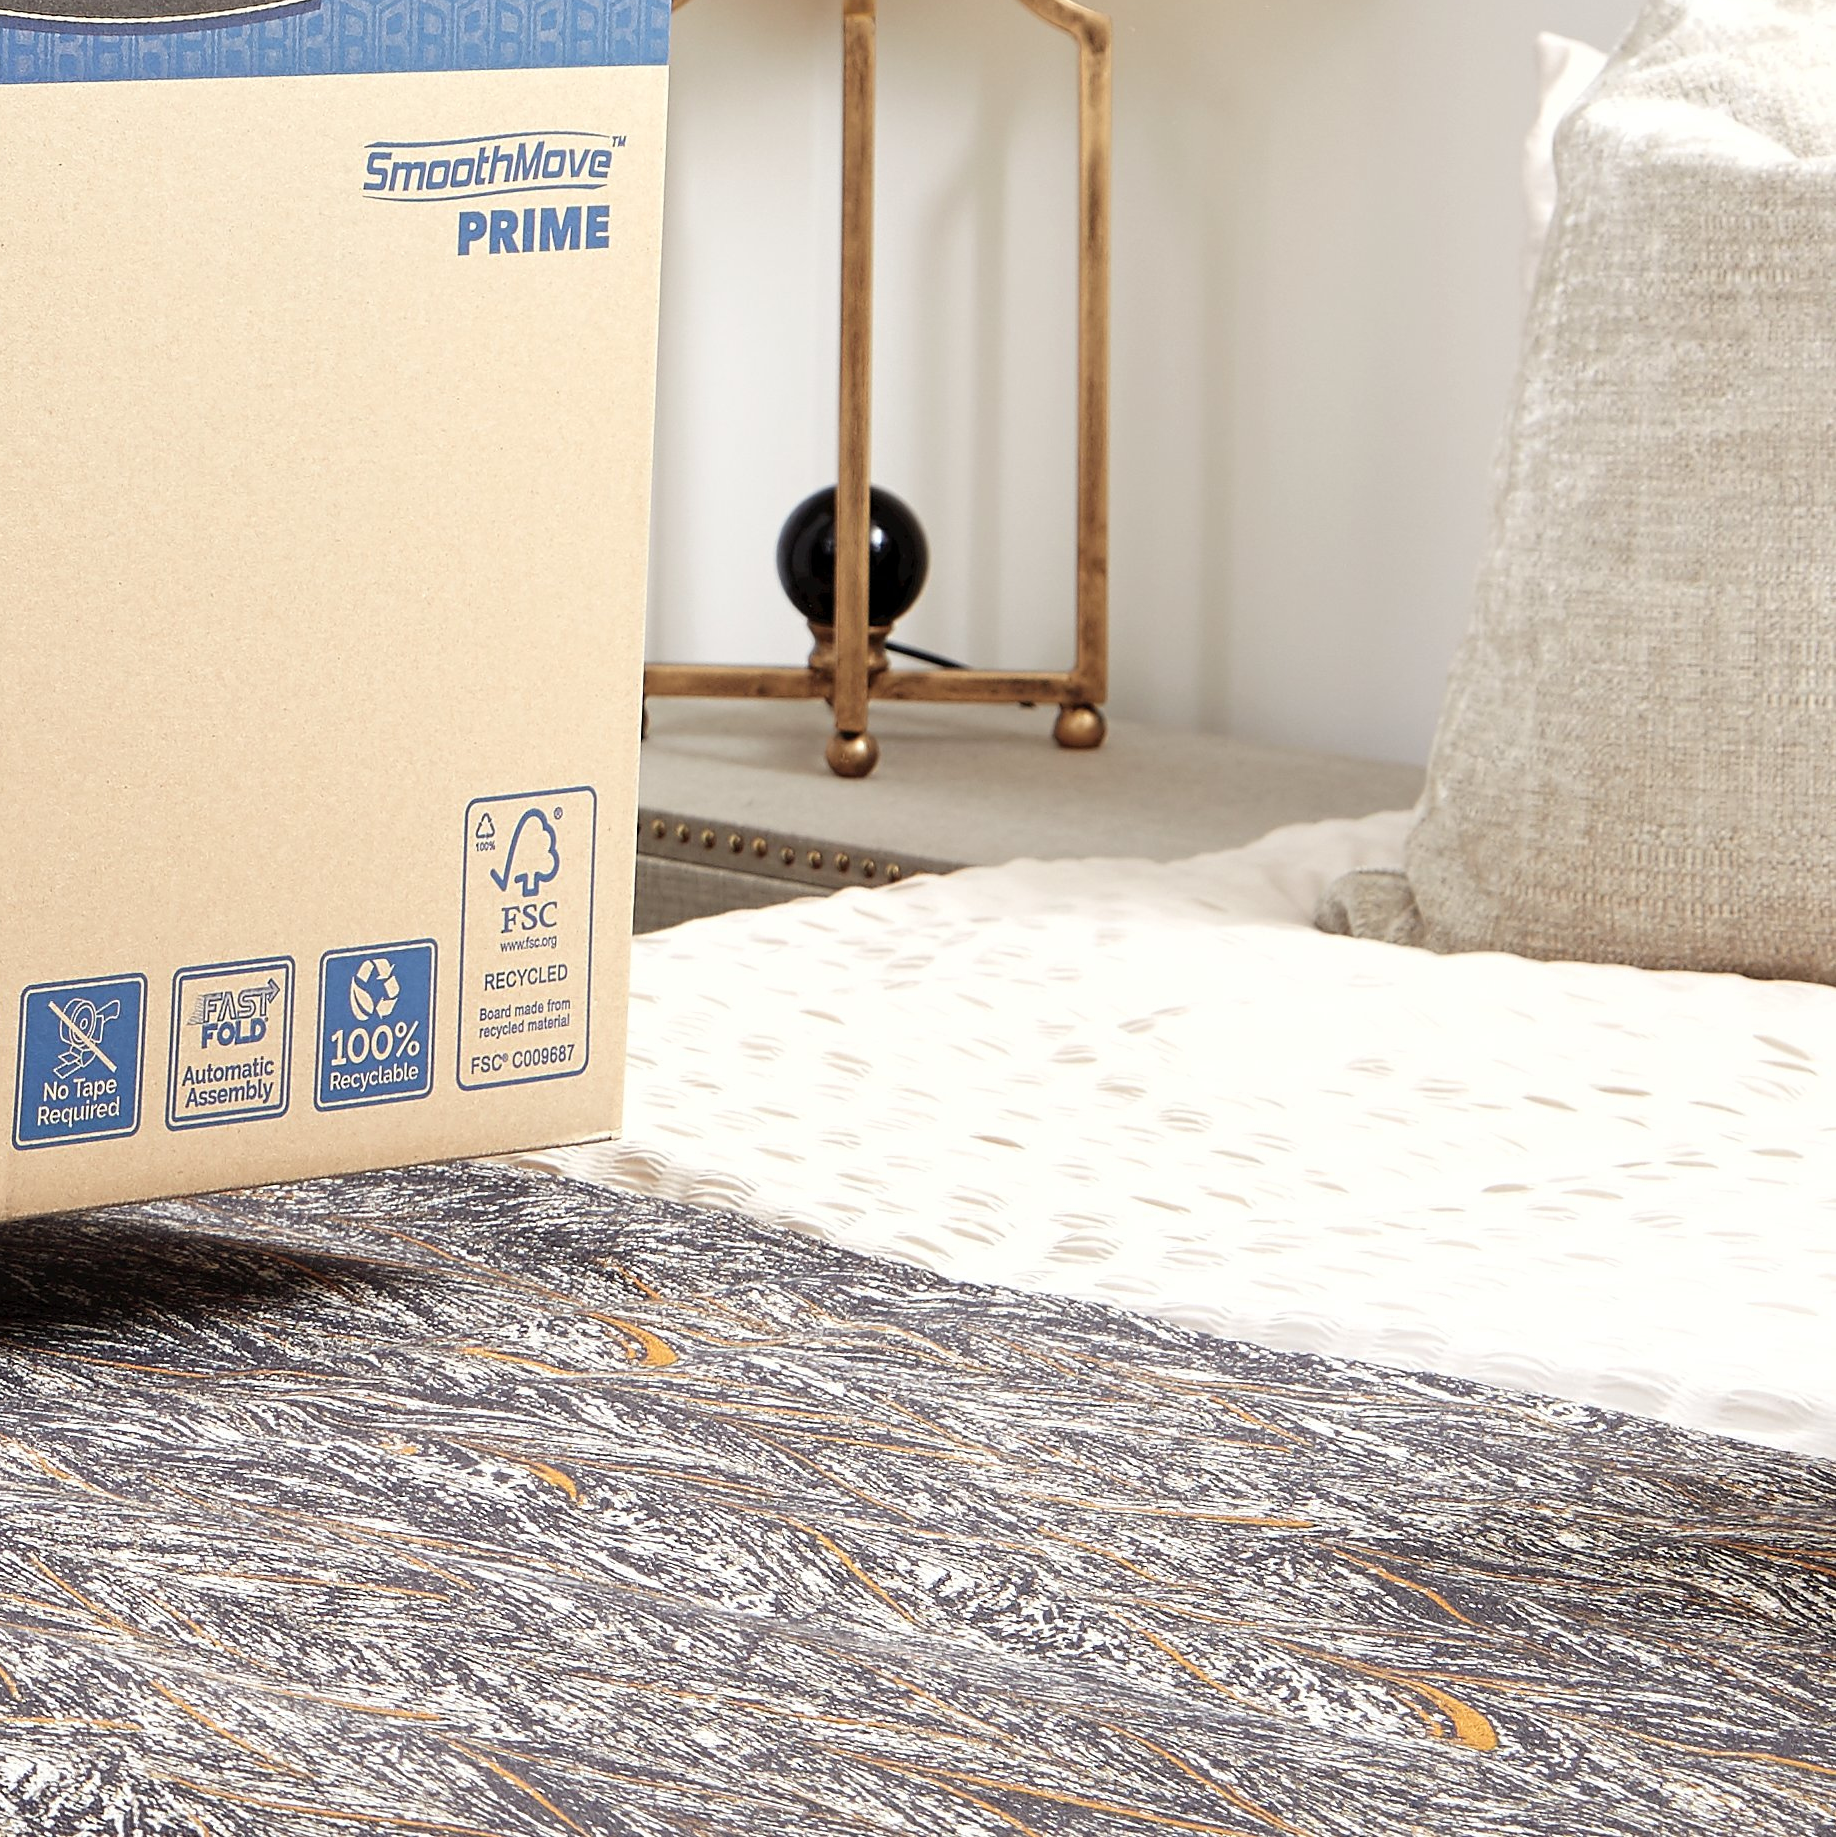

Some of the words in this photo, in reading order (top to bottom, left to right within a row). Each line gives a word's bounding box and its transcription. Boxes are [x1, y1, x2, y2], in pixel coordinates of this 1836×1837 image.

[457, 205, 610, 256] PRIME
[475, 841, 495, 852] 100%
[501, 902, 557, 934] FSC
[500, 936, 557, 952] www.fsc.org
[485, 964, 567, 991] RECYCLED
[203, 988, 272, 1023] FAST
[479, 1005, 511, 1021] Board
[515, 1001, 543, 1017] made
[547, 999, 571, 1012] from
[202, 1018, 268, 1049] FOLD
[479, 1020, 524, 1039] recycled
[528, 1014, 570, 1032] material
[331, 1020, 421, 1067] 100%
[513, 1044, 575, 1069] C009687
[182, 1057, 275, 1087] Automatic
[330, 1062, 419, 1093] Recyclable
[43, 1081, 69, 1102] No
[74, 1077, 117, 1101] Tape
[185, 1079, 275, 1108] Assembly
[37, 1097, 120, 1129] Required
